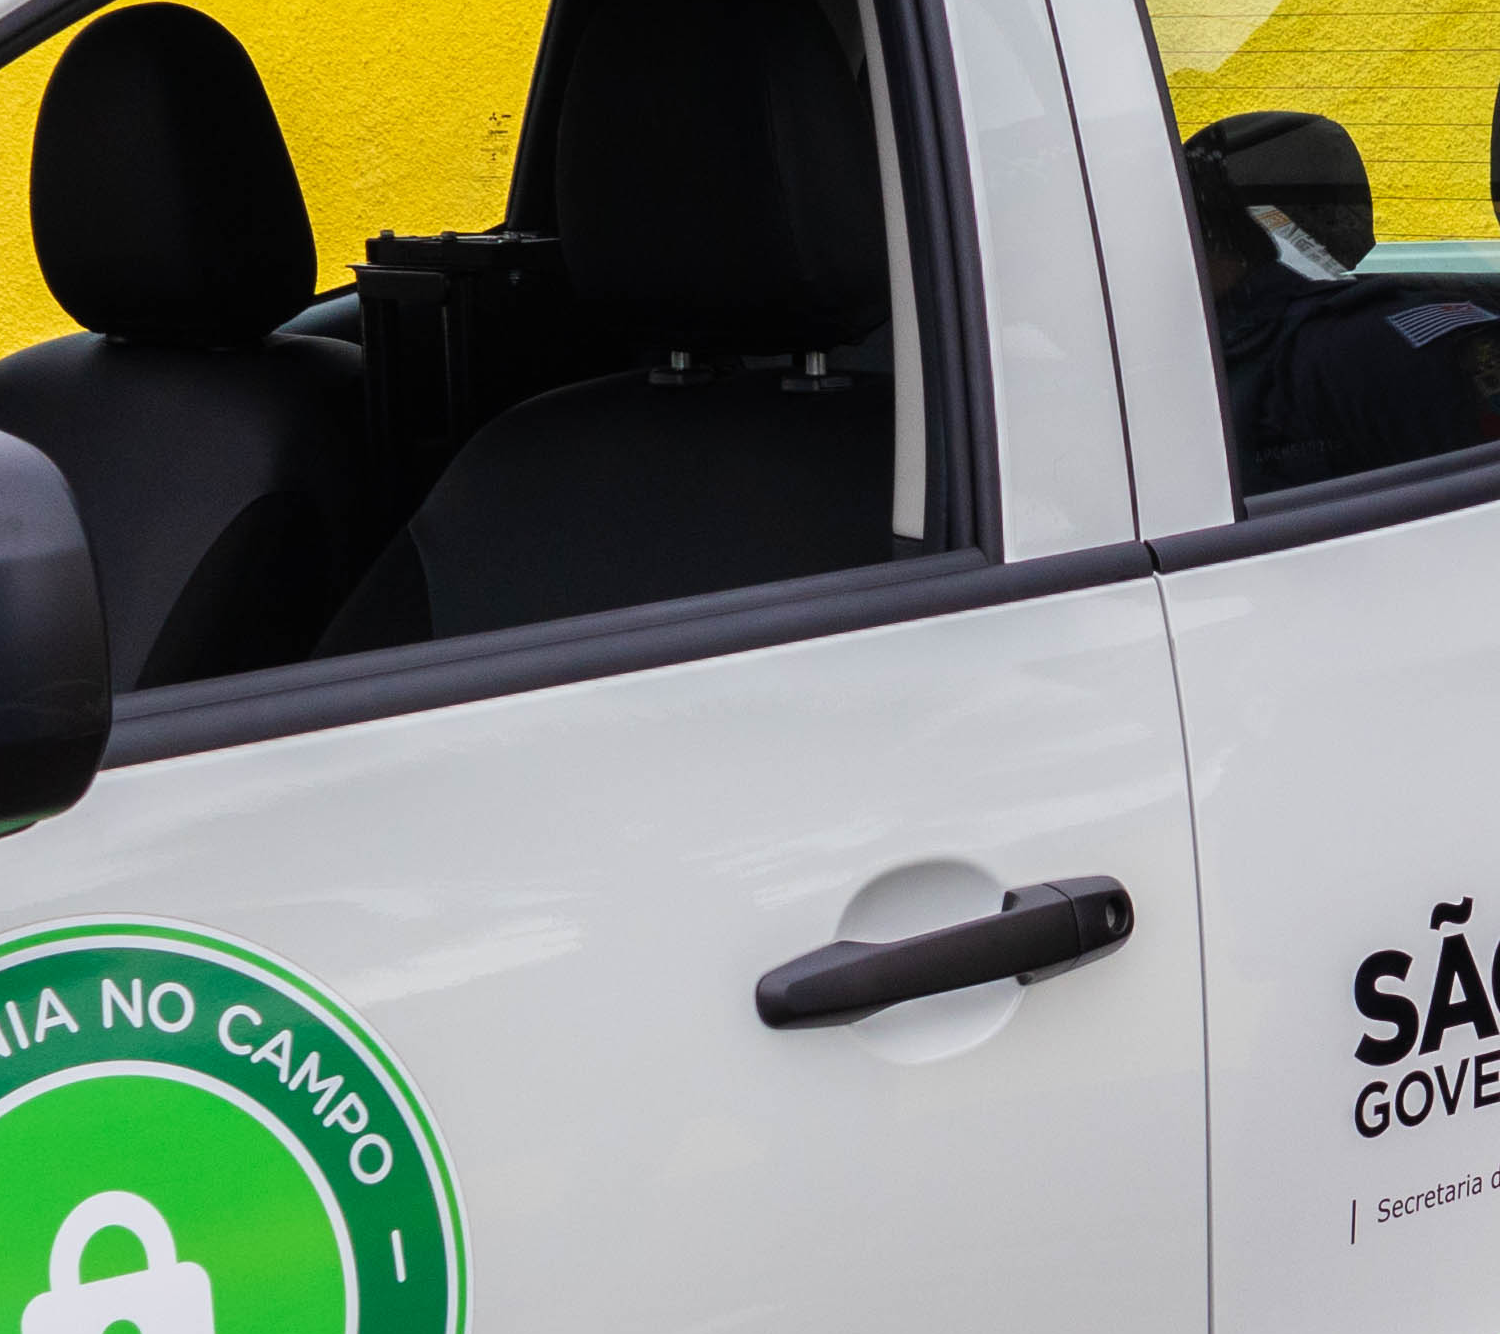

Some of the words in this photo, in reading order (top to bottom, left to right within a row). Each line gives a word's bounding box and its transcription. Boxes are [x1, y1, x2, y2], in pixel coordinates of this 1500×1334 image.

[100, 978, 196, 1033] NO
[217, 1005, 394, 1185] CAMPO
[1377, 1171, 1483, 1223] Secretaria
